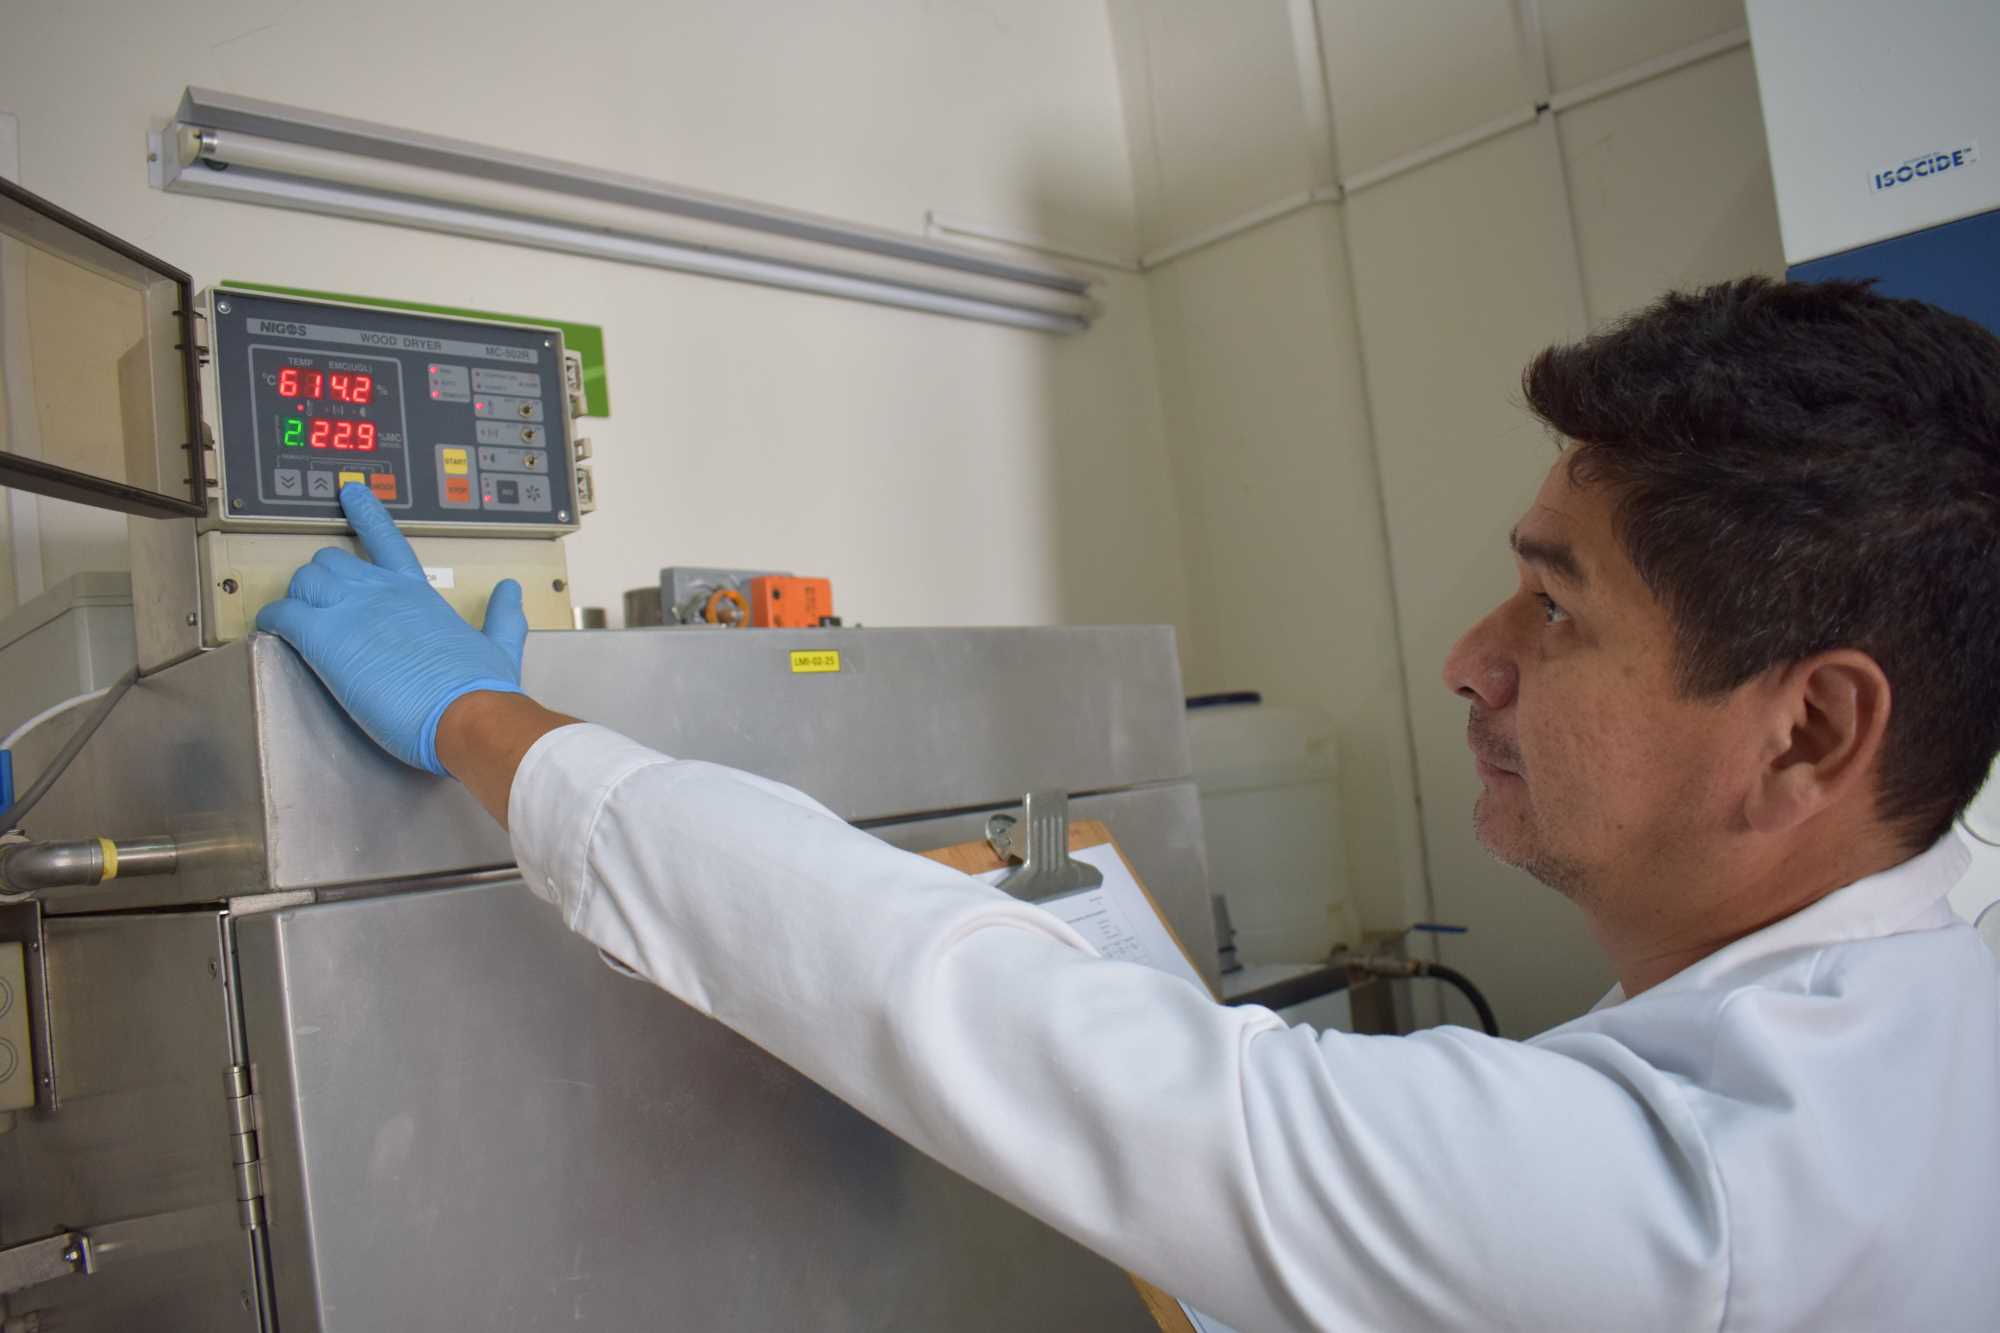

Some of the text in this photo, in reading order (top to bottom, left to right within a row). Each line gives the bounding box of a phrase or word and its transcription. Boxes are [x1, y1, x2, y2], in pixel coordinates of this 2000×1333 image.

[260, 321, 307, 336] NIGOS
[359, 333, 442, 351] WOOD DRYER
